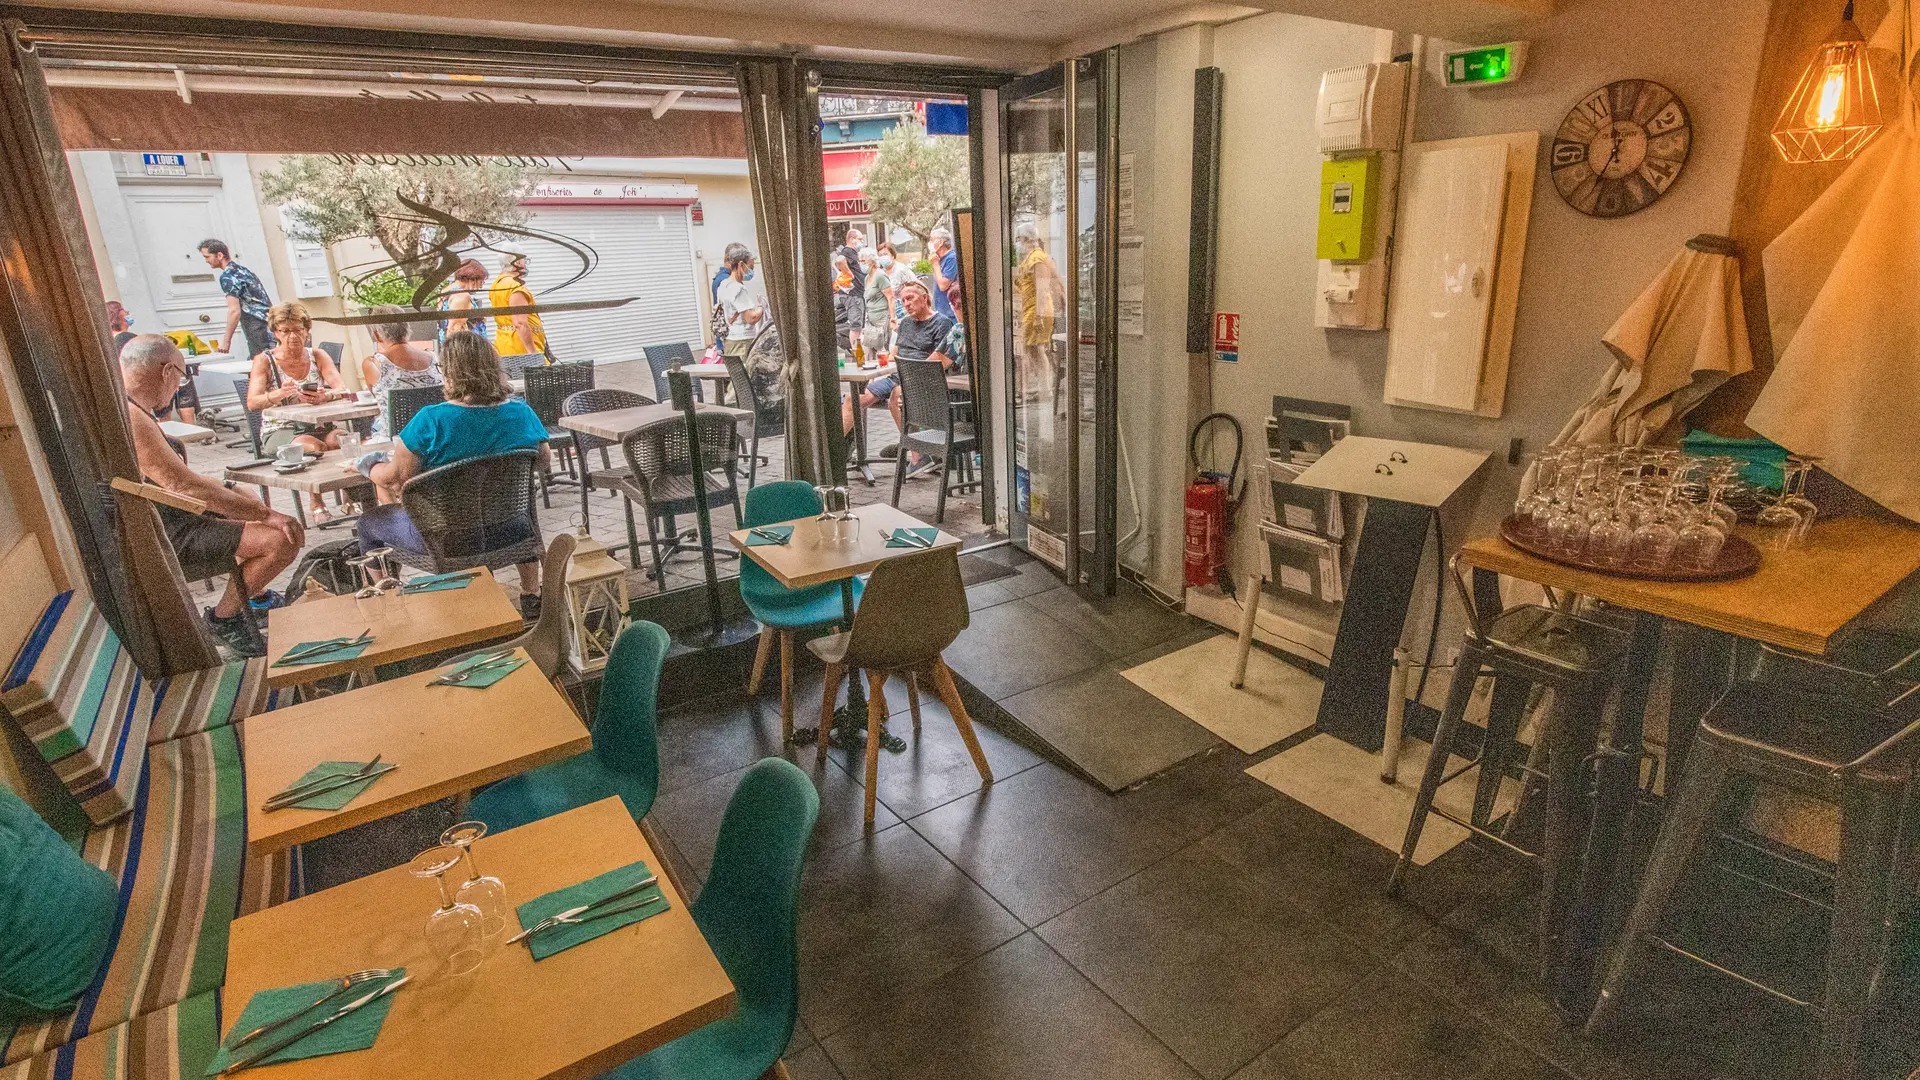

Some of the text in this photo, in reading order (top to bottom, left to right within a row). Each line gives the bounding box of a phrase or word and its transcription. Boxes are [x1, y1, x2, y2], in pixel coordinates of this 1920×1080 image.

[1655, 111, 1676, 130] 2
[149, 154, 179, 165] A LOUER
[1556, 145, 1582, 162] 9
[829, 202, 841, 211] DU
